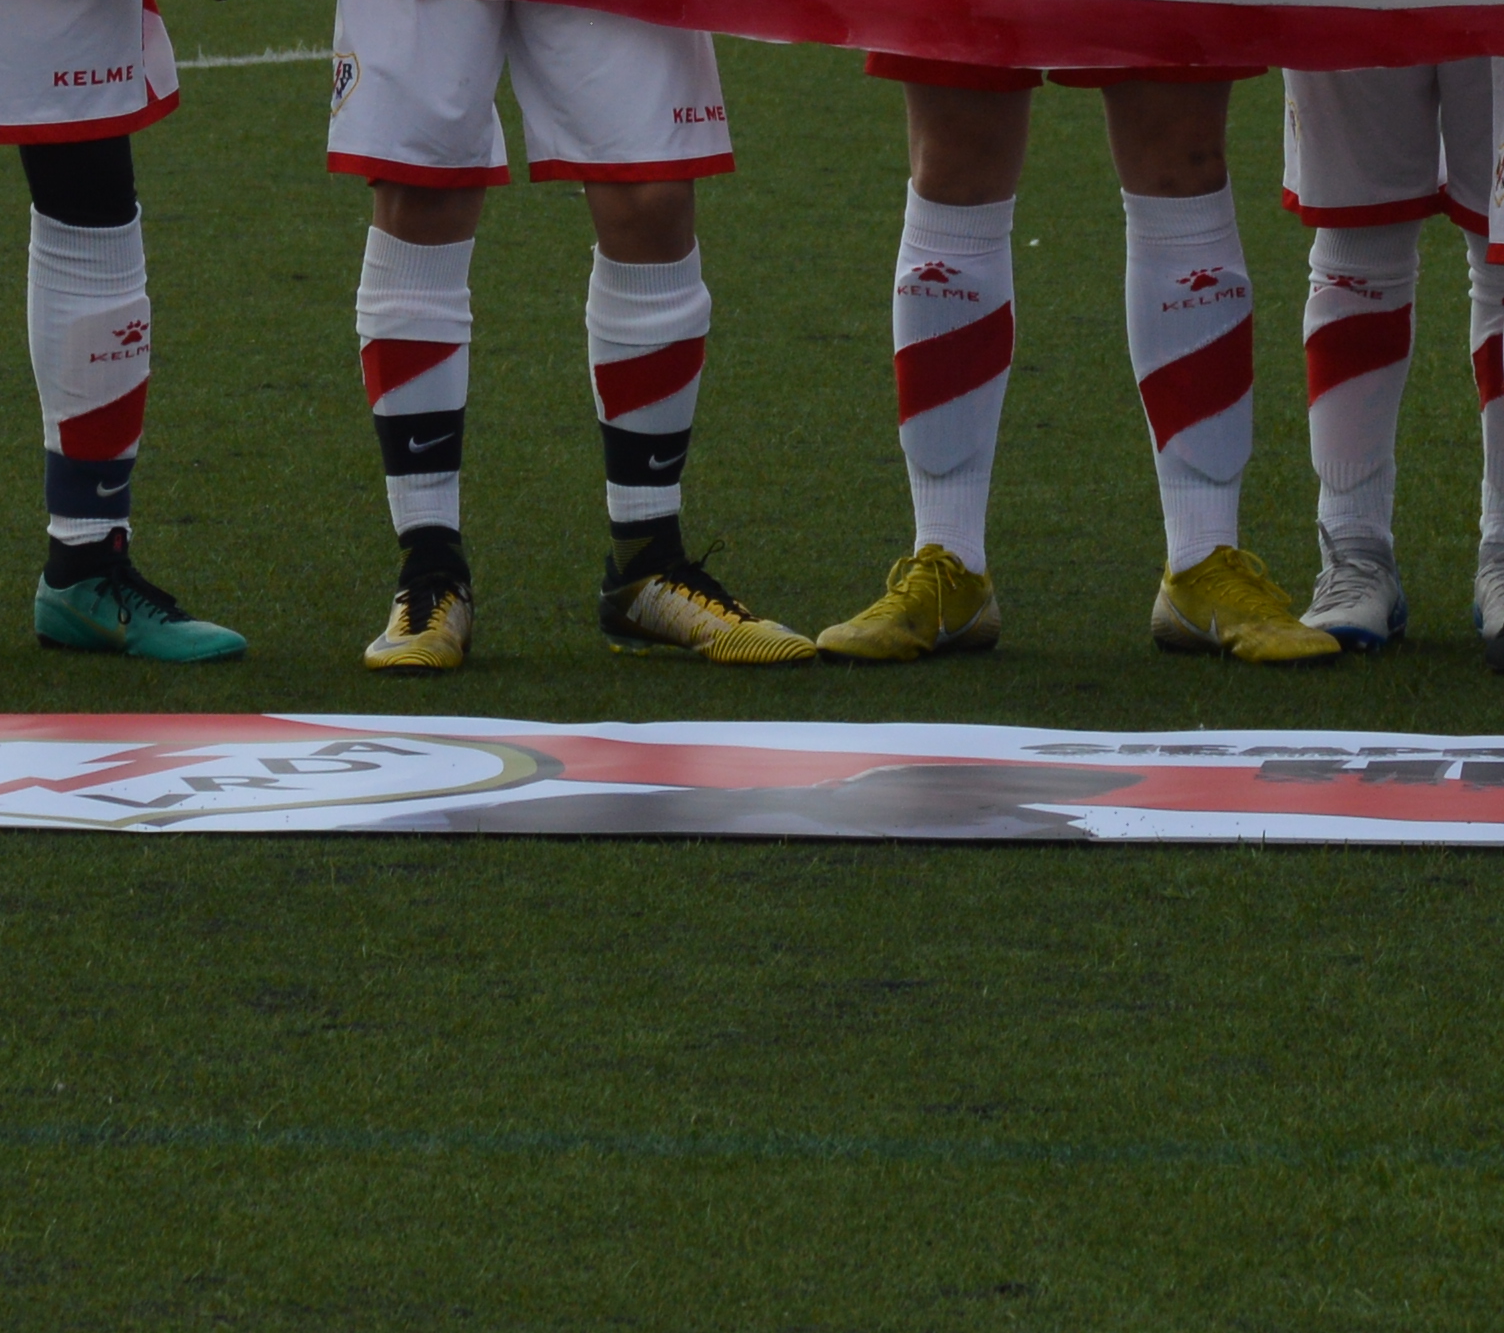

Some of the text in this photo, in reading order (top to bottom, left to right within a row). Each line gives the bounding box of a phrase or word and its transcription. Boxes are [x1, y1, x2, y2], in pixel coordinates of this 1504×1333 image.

[53, 65, 134, 87] KELME
[673, 105, 726, 124] KELME
[897, 285, 980, 303] KELME
[1161, 286, 1246, 313] KELME
